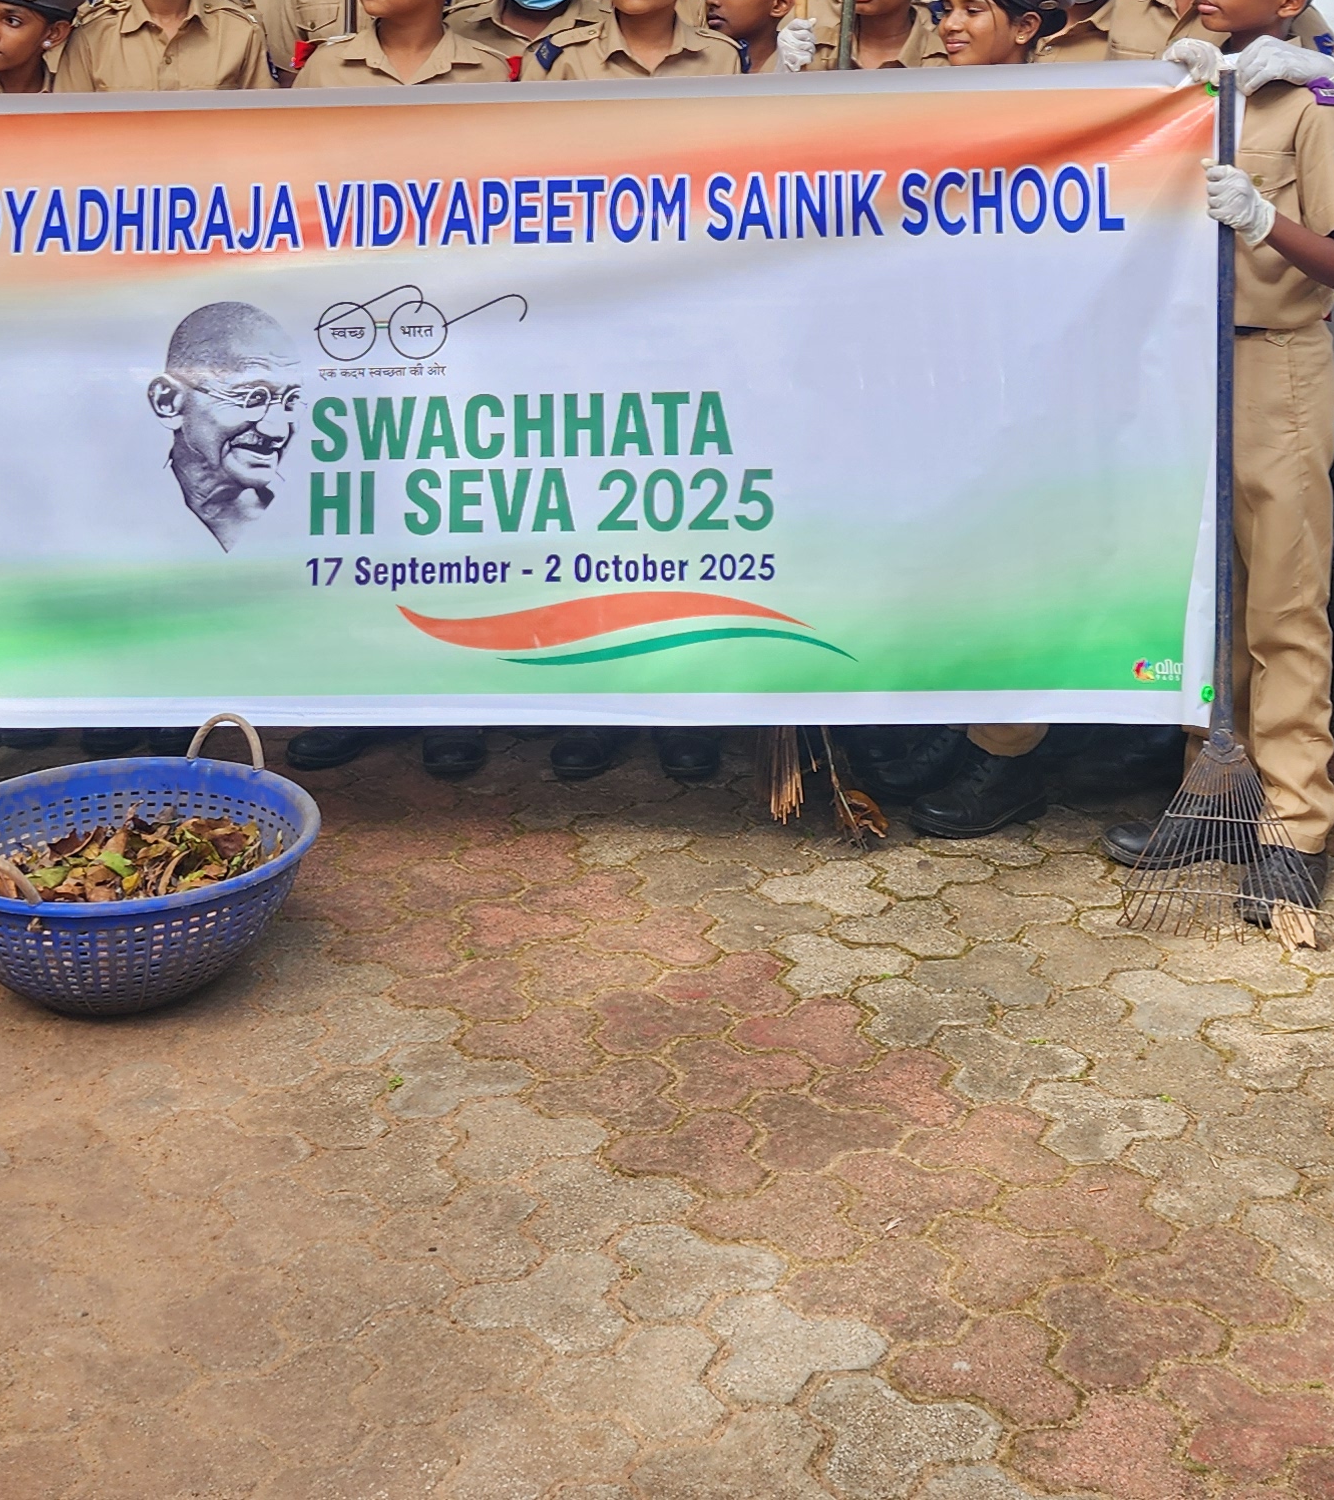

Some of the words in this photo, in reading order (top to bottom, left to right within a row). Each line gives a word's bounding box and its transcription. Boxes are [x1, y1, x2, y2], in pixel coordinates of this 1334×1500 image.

[316, 176, 687, 247] VIDYAPEETOM
[706, 171, 885, 241] SAINIK
[901, 165, 1126, 236] SCHOOL
[329, 326, 366, 340] स्वच्छ
[399, 325, 434, 338] भारत
[318, 368, 338, 381] एक
[339, 367, 366, 379] कदम
[368, 367, 406, 378] स्वच्छता
[409, 363, 425, 377] की
[427, 362, 447, 376] ओर
[310, 391, 734, 462] SWACHHATA
[310, 470, 376, 536] HI
[404, 467, 576, 536] SEVA
[597, 468, 775, 532] 2025
[305, 556, 344, 587] 17
[354, 555, 511, 592] September
[545, 554, 563, 584] 2
[573, 553, 689, 583] October
[699, 553, 776, 582] 2025
